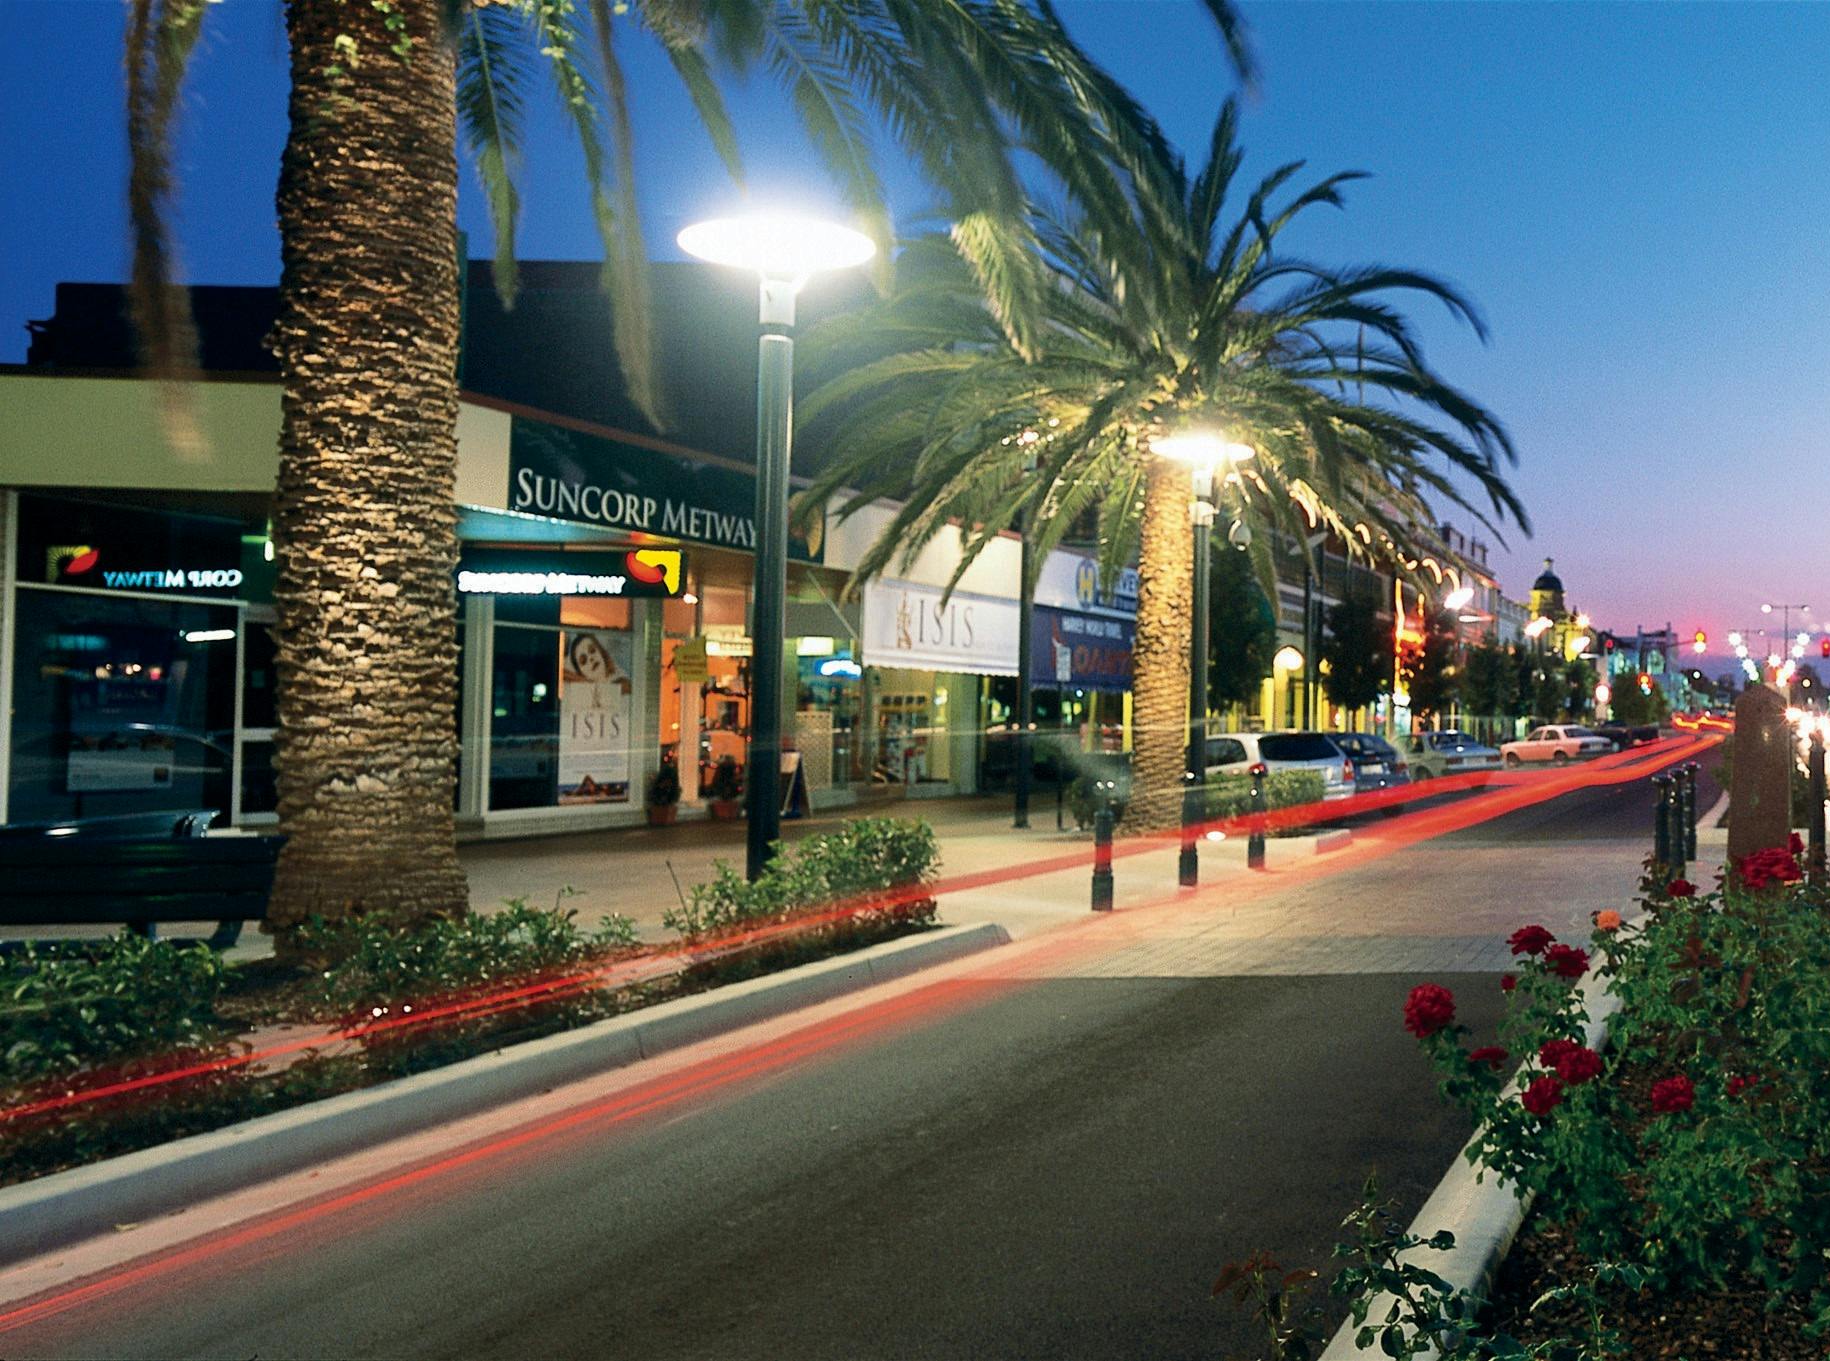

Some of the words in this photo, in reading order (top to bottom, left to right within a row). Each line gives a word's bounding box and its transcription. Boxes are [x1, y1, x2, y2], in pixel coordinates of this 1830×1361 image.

[516, 467, 657, 529] SUNCORP
[662, 498, 756, 547] METWAY
[545, 572, 626, 593] METWAY
[919, 600, 974, 648] ISIS
[572, 712, 621, 740] ISIS
